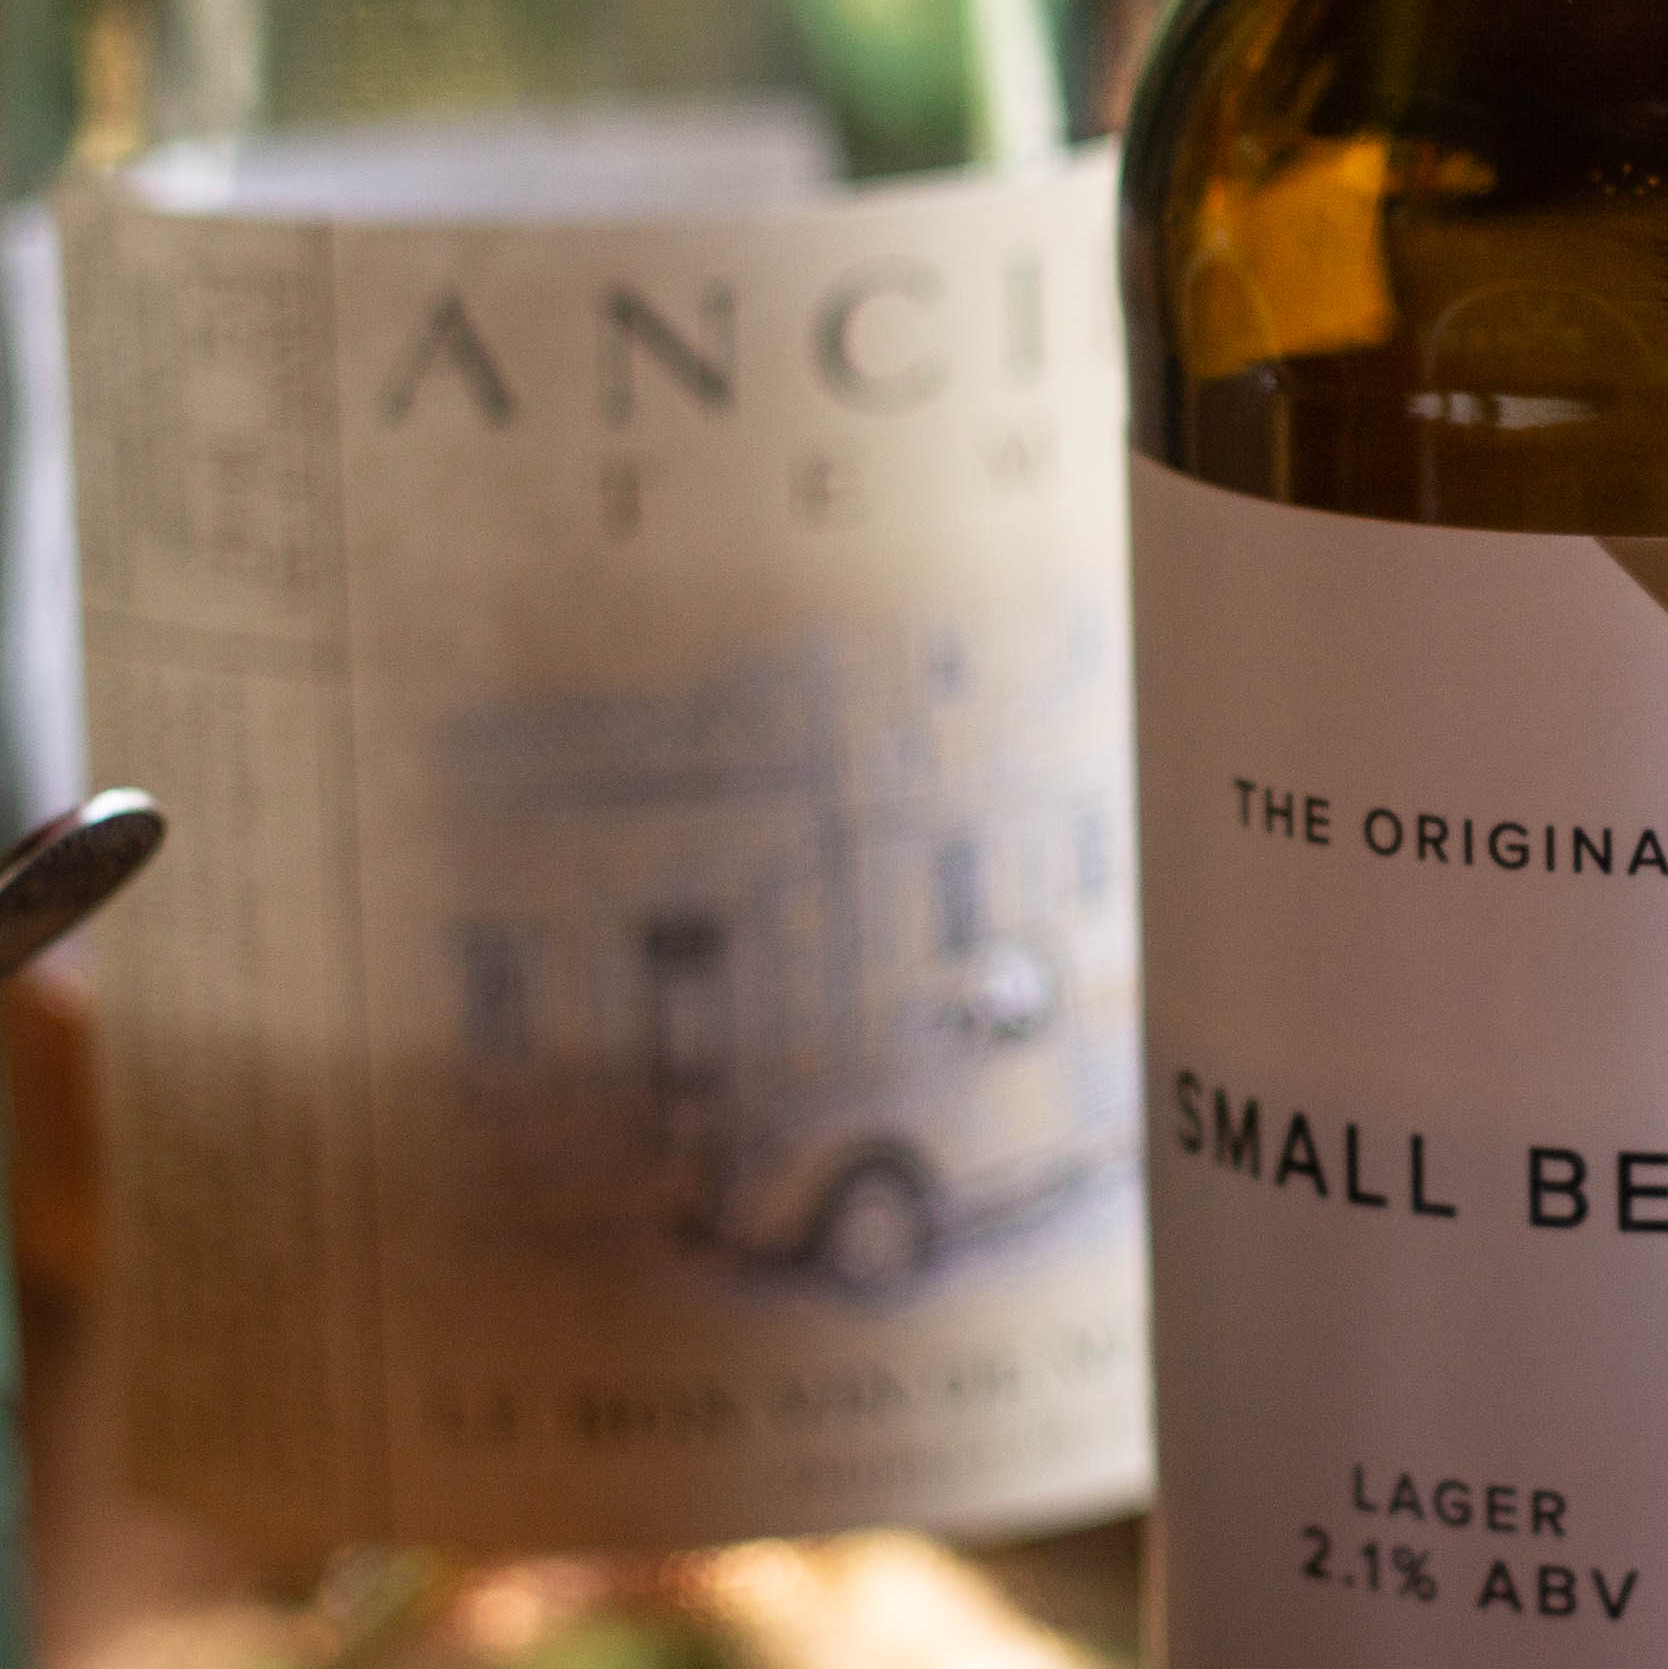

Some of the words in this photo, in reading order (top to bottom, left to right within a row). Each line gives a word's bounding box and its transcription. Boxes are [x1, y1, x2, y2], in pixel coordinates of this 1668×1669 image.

[374, 244, 1116, 430] ANCI
[1232, 776, 1332, 847] THE
[1170, 1066, 1458, 1220] SMALL
[1352, 1463, 1568, 1538] LAGER
[1299, 1526, 1438, 1603] 2.1%
[1476, 1559, 1640, 1622] ABV
